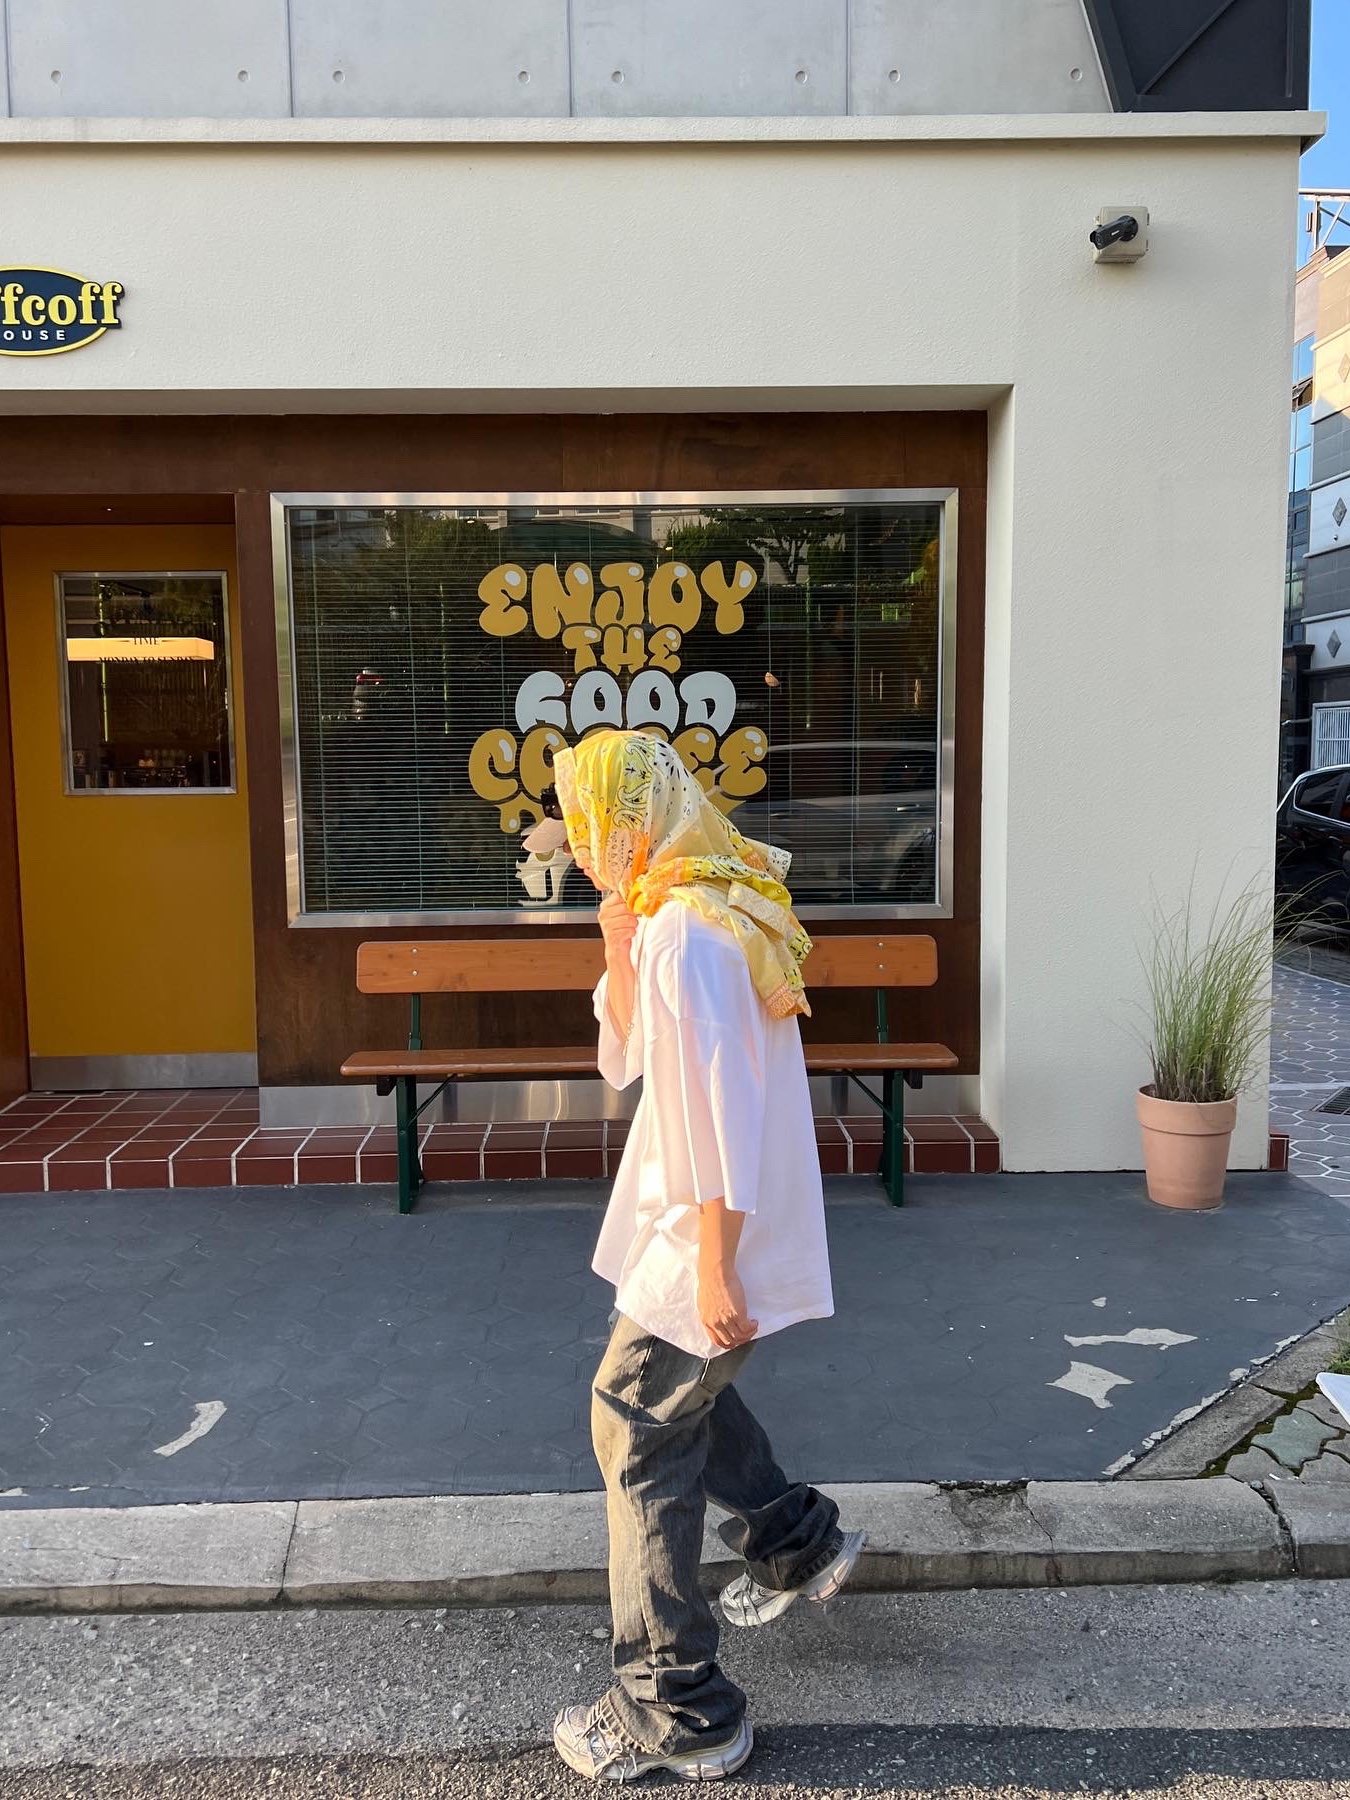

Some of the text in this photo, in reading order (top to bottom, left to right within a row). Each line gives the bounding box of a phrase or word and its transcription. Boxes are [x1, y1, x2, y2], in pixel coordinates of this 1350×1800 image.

[0, 282, 123, 326] fcoff
[477, 560, 757, 639] ENJOY
[133, 636, 160, 646] TIME
[562, 626, 682, 675] THE
[515, 670, 737, 737] GOOD
[468, 726, 768, 801] COEE
